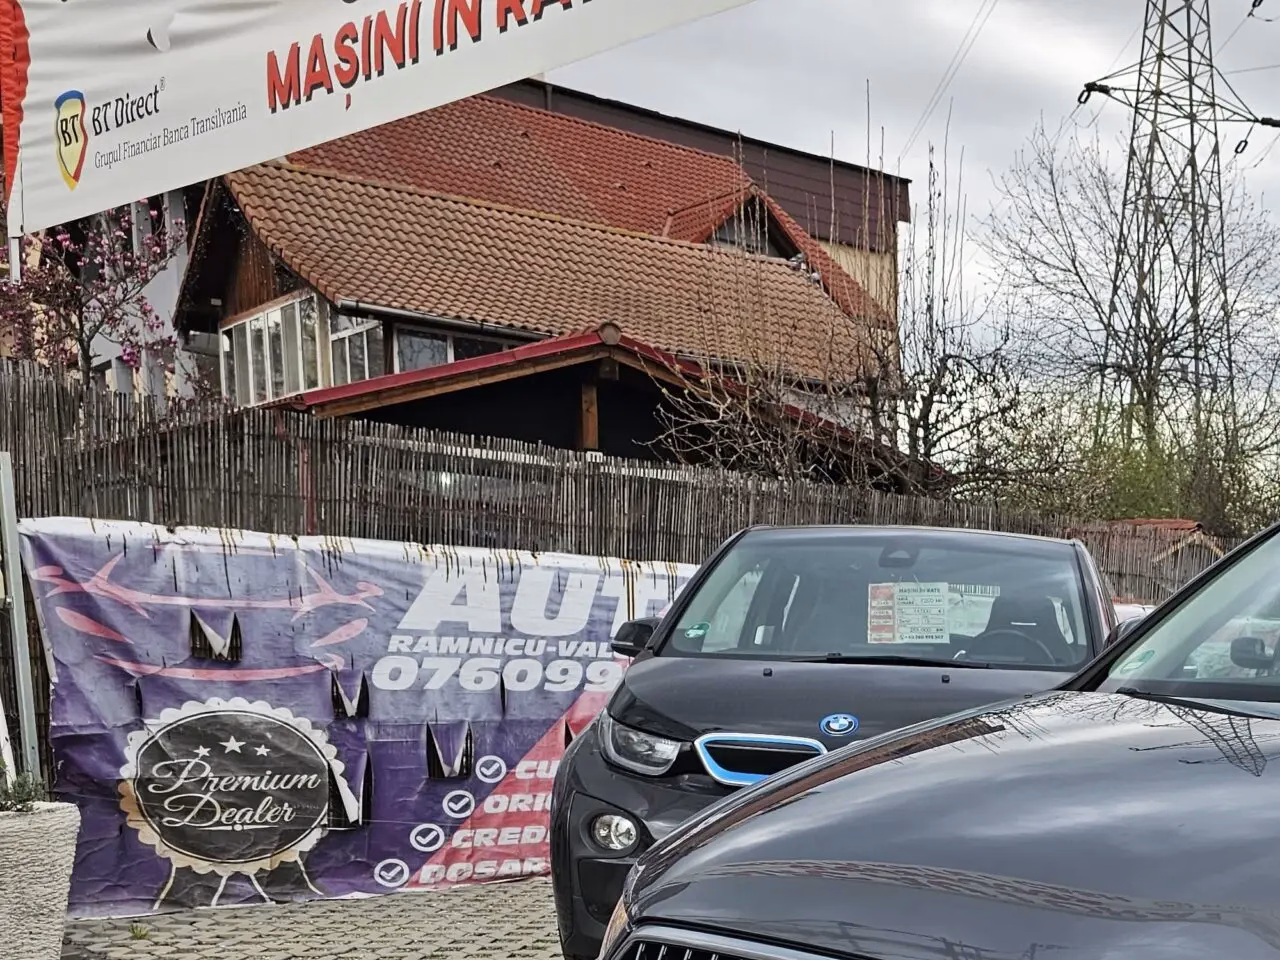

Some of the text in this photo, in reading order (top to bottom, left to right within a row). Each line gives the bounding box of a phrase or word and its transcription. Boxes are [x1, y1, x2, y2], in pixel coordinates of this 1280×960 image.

[60, 113, 79, 147] BT
[92, 101, 111, 136] BT
[94, 101, 247, 169] Grupul Financiar Banca Transilvania
[148, 755, 321, 794] Premium
[161, 792, 296, 827] Dealer
